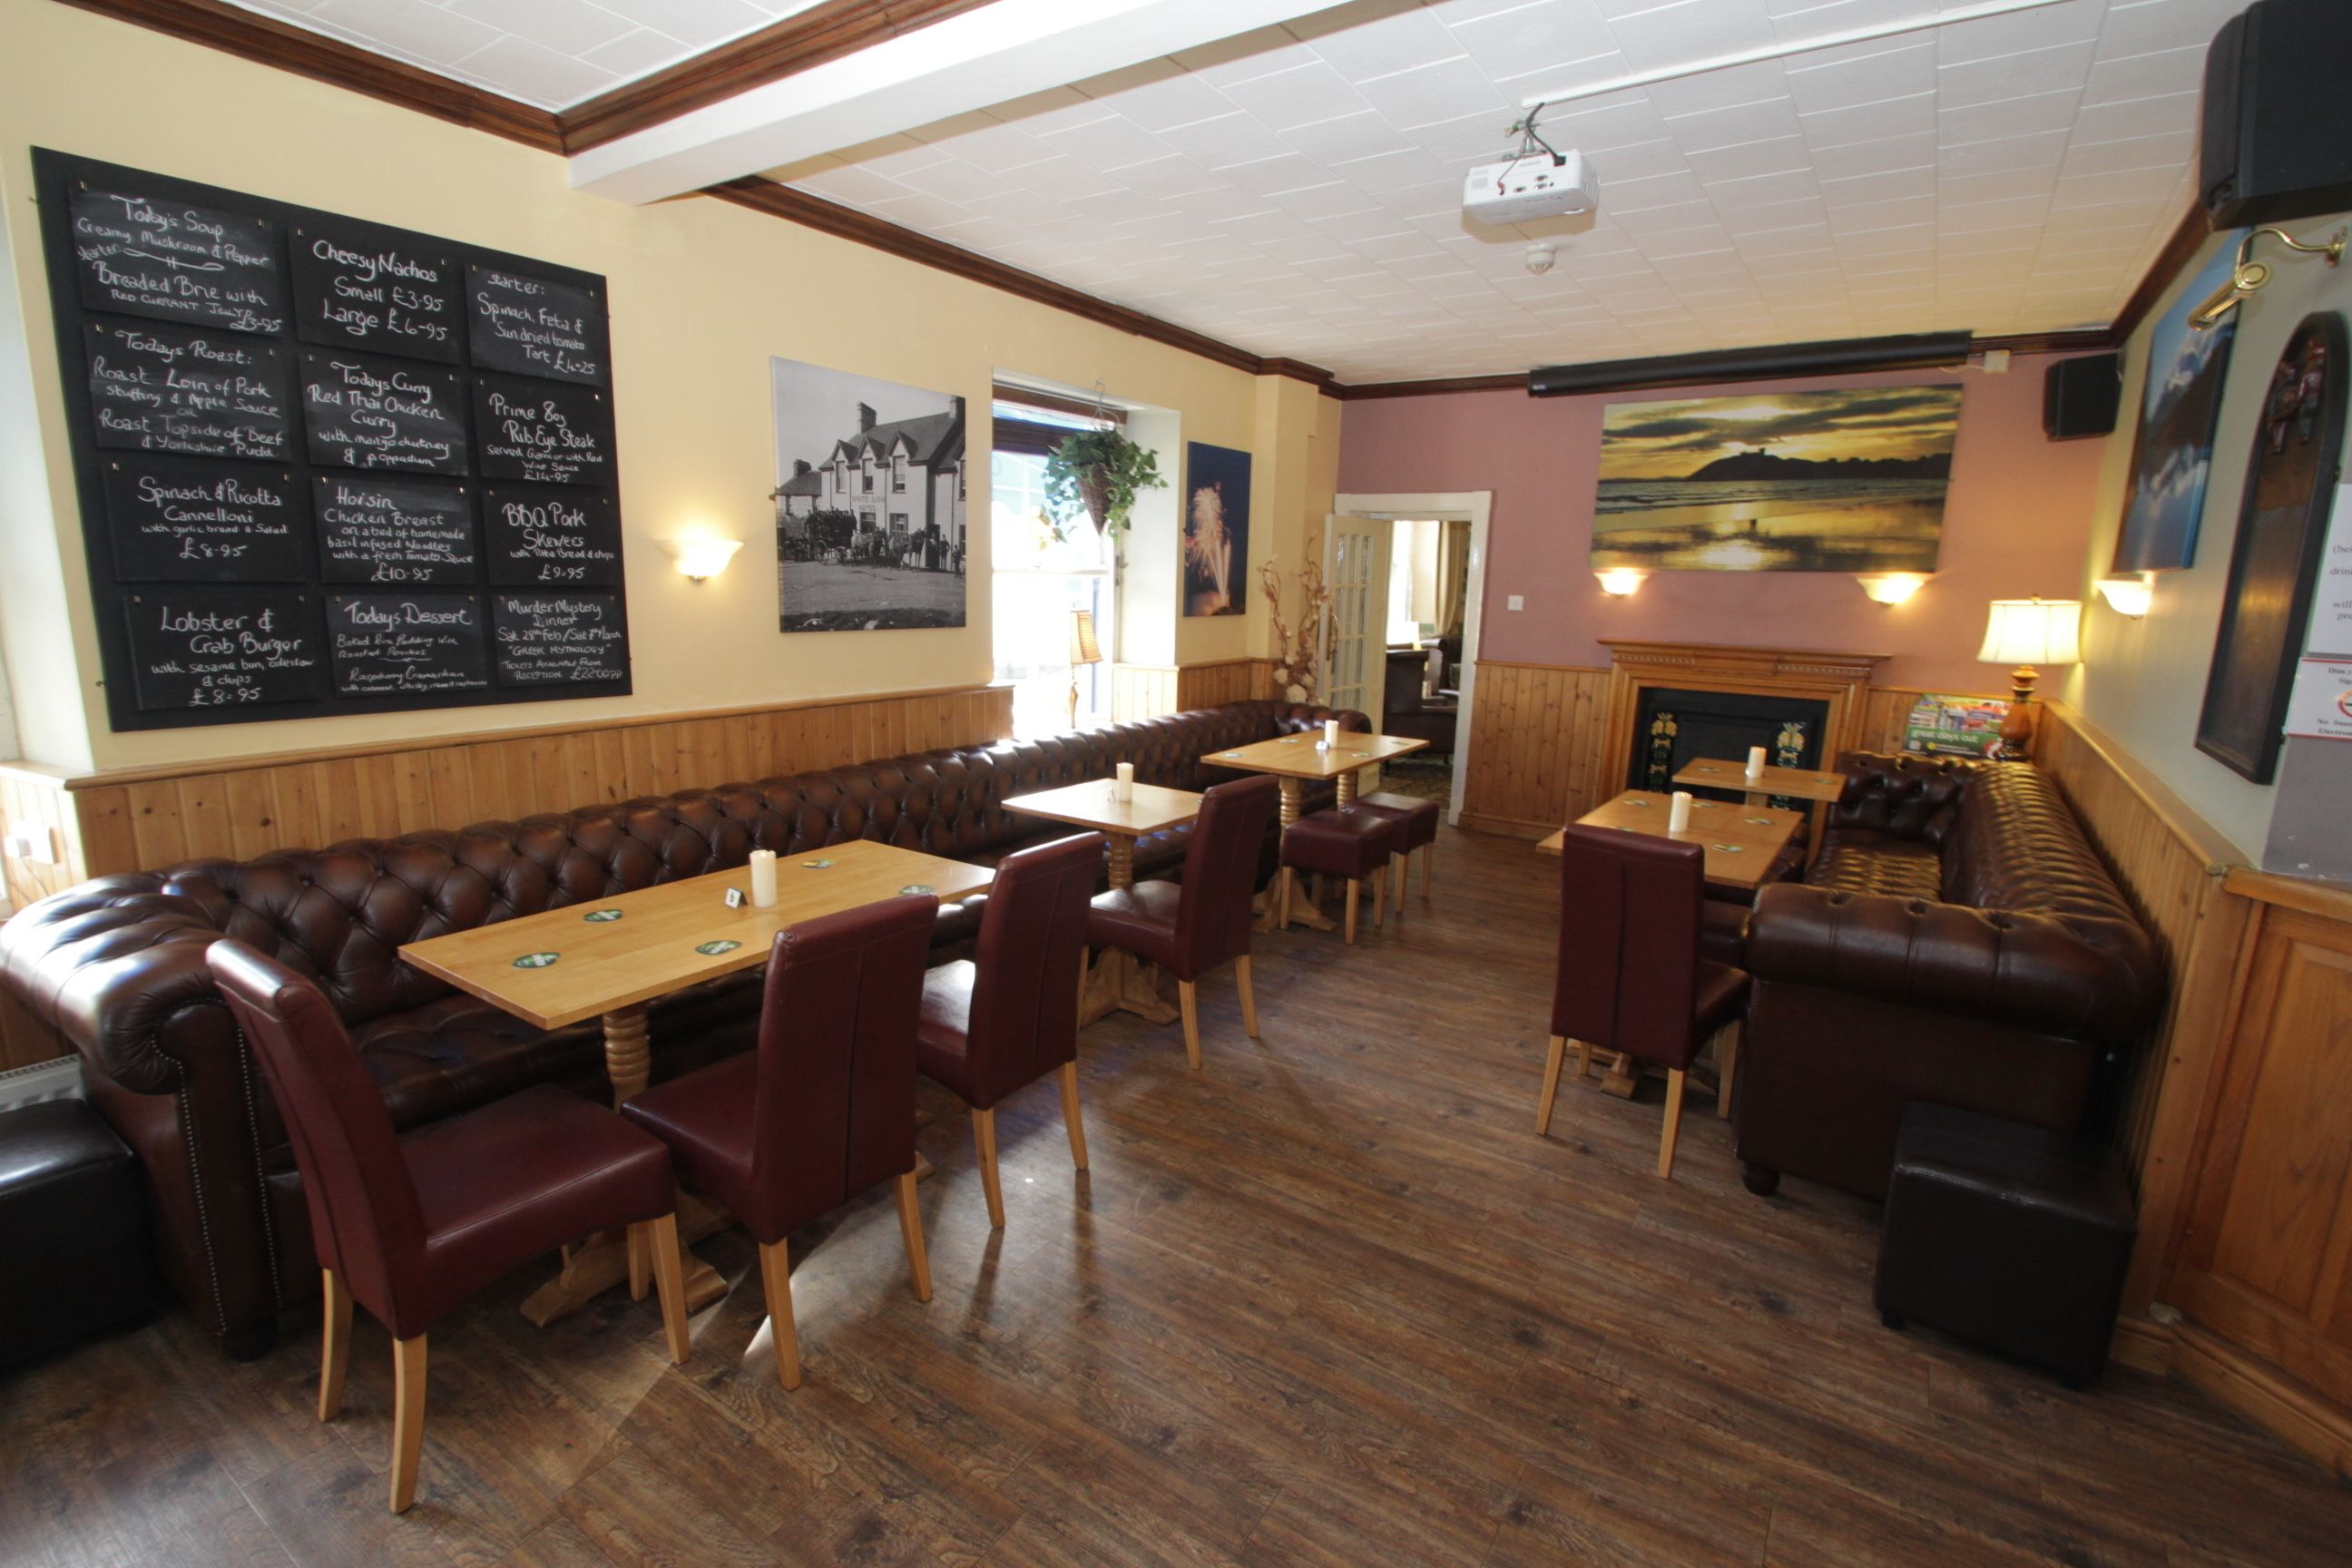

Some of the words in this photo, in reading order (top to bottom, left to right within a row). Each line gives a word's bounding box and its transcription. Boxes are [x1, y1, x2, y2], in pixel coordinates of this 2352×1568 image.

[111, 194, 178, 232] Today's
[184, 211, 224, 243] Soup
[77, 217, 132, 244] Creamy
[142, 231, 207, 255] Mushroom
[224, 244, 270, 266] Pepper
[313, 239, 377, 282] Cheesy
[377, 251, 438, 283] Nachos
[93, 260, 170, 293] Breaded
[174, 275, 220, 300] Brie
[226, 289, 268, 306] with
[334, 276, 384, 303] Small
[141, 294, 200, 311] CURRANT
[323, 298, 379, 336] Large
[539, 308, 571, 331] Feta
[114, 329, 184, 363] Todays
[188, 339, 252, 365] Roast:
[495, 321, 518, 340] Sun
[520, 327, 551, 346] dried
[552, 332, 585, 350] tomato
[522, 344, 551, 364] Tart
[93, 355, 152, 386] Roast
[166, 368, 210, 393] Loin
[214, 383, 230, 397] of
[235, 377, 271, 398] Pork
[329, 361, 390, 397] Todays
[392, 371, 433, 405] Curry
[189, 393, 227, 410] Apple
[232, 397, 282, 419] Sauce
[307, 383, 342, 407] Red
[348, 390, 381, 410] Thai
[384, 396, 446, 422] Chicken
[488, 392, 537, 421] Prime
[543, 400, 567, 428] 8oz
[99, 407, 151, 433] Roast
[159, 414, 220, 439] Topside
[223, 426, 242, 445] of
[242, 426, 284, 446] Beef
[350, 408, 397, 440] Curry
[155, 435, 225, 454] Yorkshire
[318, 426, 353, 444] with
[355, 435, 396, 451] mango
[397, 436, 451, 460] chutney
[502, 418, 534, 445] Rib
[535, 424, 558, 454] Eye
[559, 428, 596, 449] Steak
[366, 452, 436, 468] poppadum
[486, 443, 524, 457] Served
[565, 453, 588, 462] with
[586, 451, 603, 463] Red
[521, 460, 547, 471] Wine
[551, 462, 580, 472] Sauce
[137, 475, 212, 508] Spinach
[225, 477, 283, 506] Ricotta
[336, 485, 397, 511] Hoisin
[163, 505, 255, 524] Cannelloni
[324, 507, 387, 525] Chicken
[391, 510, 446, 527] Breast
[501, 502, 549, 528] BBQ
[548, 501, 587, 527] Pork
[141, 523, 171, 534] with
[172, 524, 204, 538] garlic
[206, 524, 240, 534] bread
[254, 524, 289, 534] Salad
[341, 526, 359, 536] on
[361, 528, 369, 536] a
[370, 525, 393, 537] bed
[395, 526, 408, 540] of
[410, 527, 466, 541] homemade
[523, 527, 585, 550] Skewers
[327, 534, 357, 549] basil
[360, 538, 402, 553] infused
[509, 548, 531, 559] with
[555, 547, 585, 560] Bread
[594, 549, 615, 562] chips
[332, 549, 358, 560] with
[360, 552, 369, 560] a
[372, 551, 403, 564] fresh
[405, 549, 442, 563] Tomato
[441, 552, 475, 564] Sauce
[161, 605, 248, 632] Lobster
[343, 600, 401, 632] Todays
[400, 602, 473, 625] Dessert
[507, 598, 554, 615] Murder
[554, 598, 603, 621] Mystery
[532, 612, 579, 628] Dinner
[337, 633, 370, 648] Baked
[373, 632, 394, 646] Rice
[394, 632, 434, 647] Pudding
[497, 626, 521, 642] Sat
[189, 633, 235, 654] Crab
[239, 631, 303, 661] Burger
[338, 649, 380, 660] Roasted
[387, 646, 427, 658] Peaches
[150, 661, 185, 674] with
[189, 662, 237, 674] sesame
[268, 658, 315, 669] coleslaw
[348, 666, 405, 685] Raspberry
[514, 670, 563, 681] RECEPTION
[340, 684, 359, 692] with
